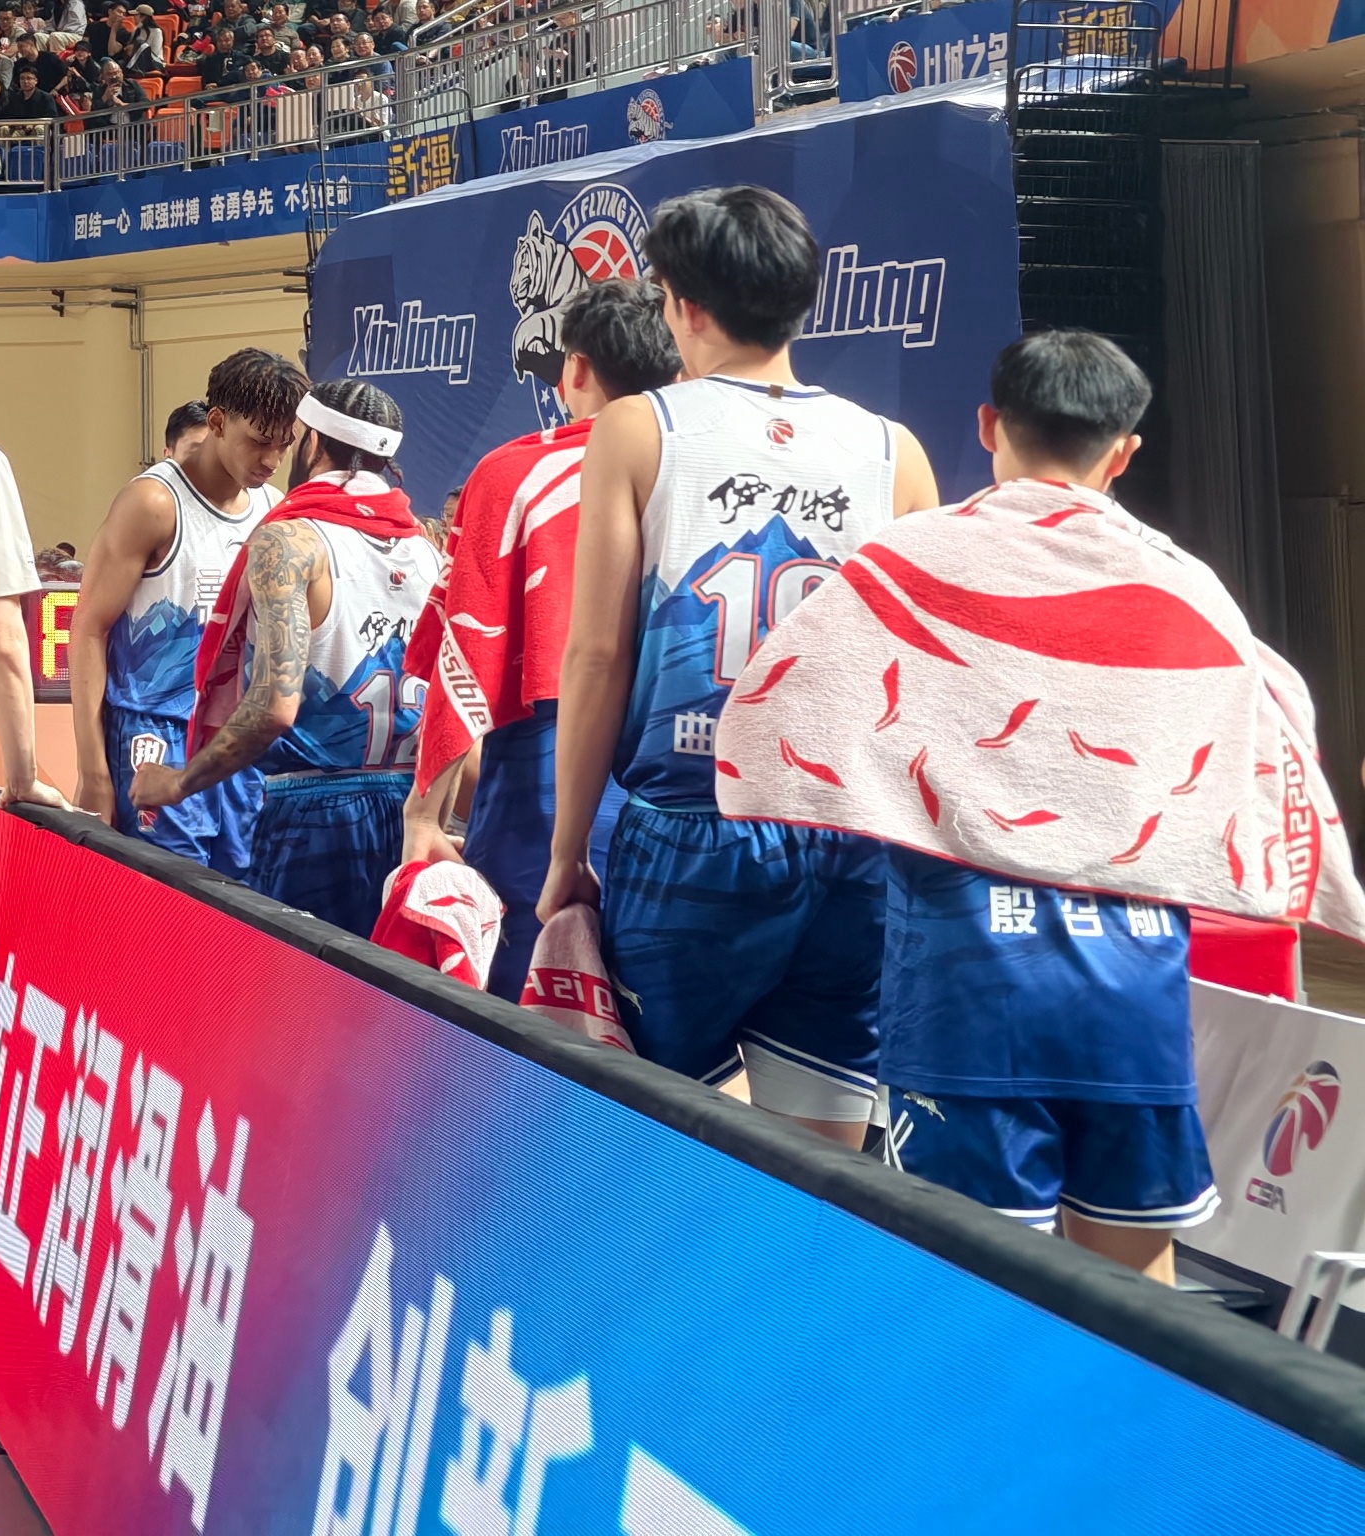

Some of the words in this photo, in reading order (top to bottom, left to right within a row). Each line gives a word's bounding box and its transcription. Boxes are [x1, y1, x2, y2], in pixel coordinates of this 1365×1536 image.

[74, 208, 131, 241] 团结一心
[139, 197, 200, 232] 顽强拼搏
[210, 187, 274, 223] 奋勇争先
[581, 190, 627, 221] FLYING
[800, 244, 946, 349] Jiang
[347, 299, 475, 385] XinJiang
[707, 473, 851, 532] 伊力特
[1245, 1177, 1288, 1216] CBA
